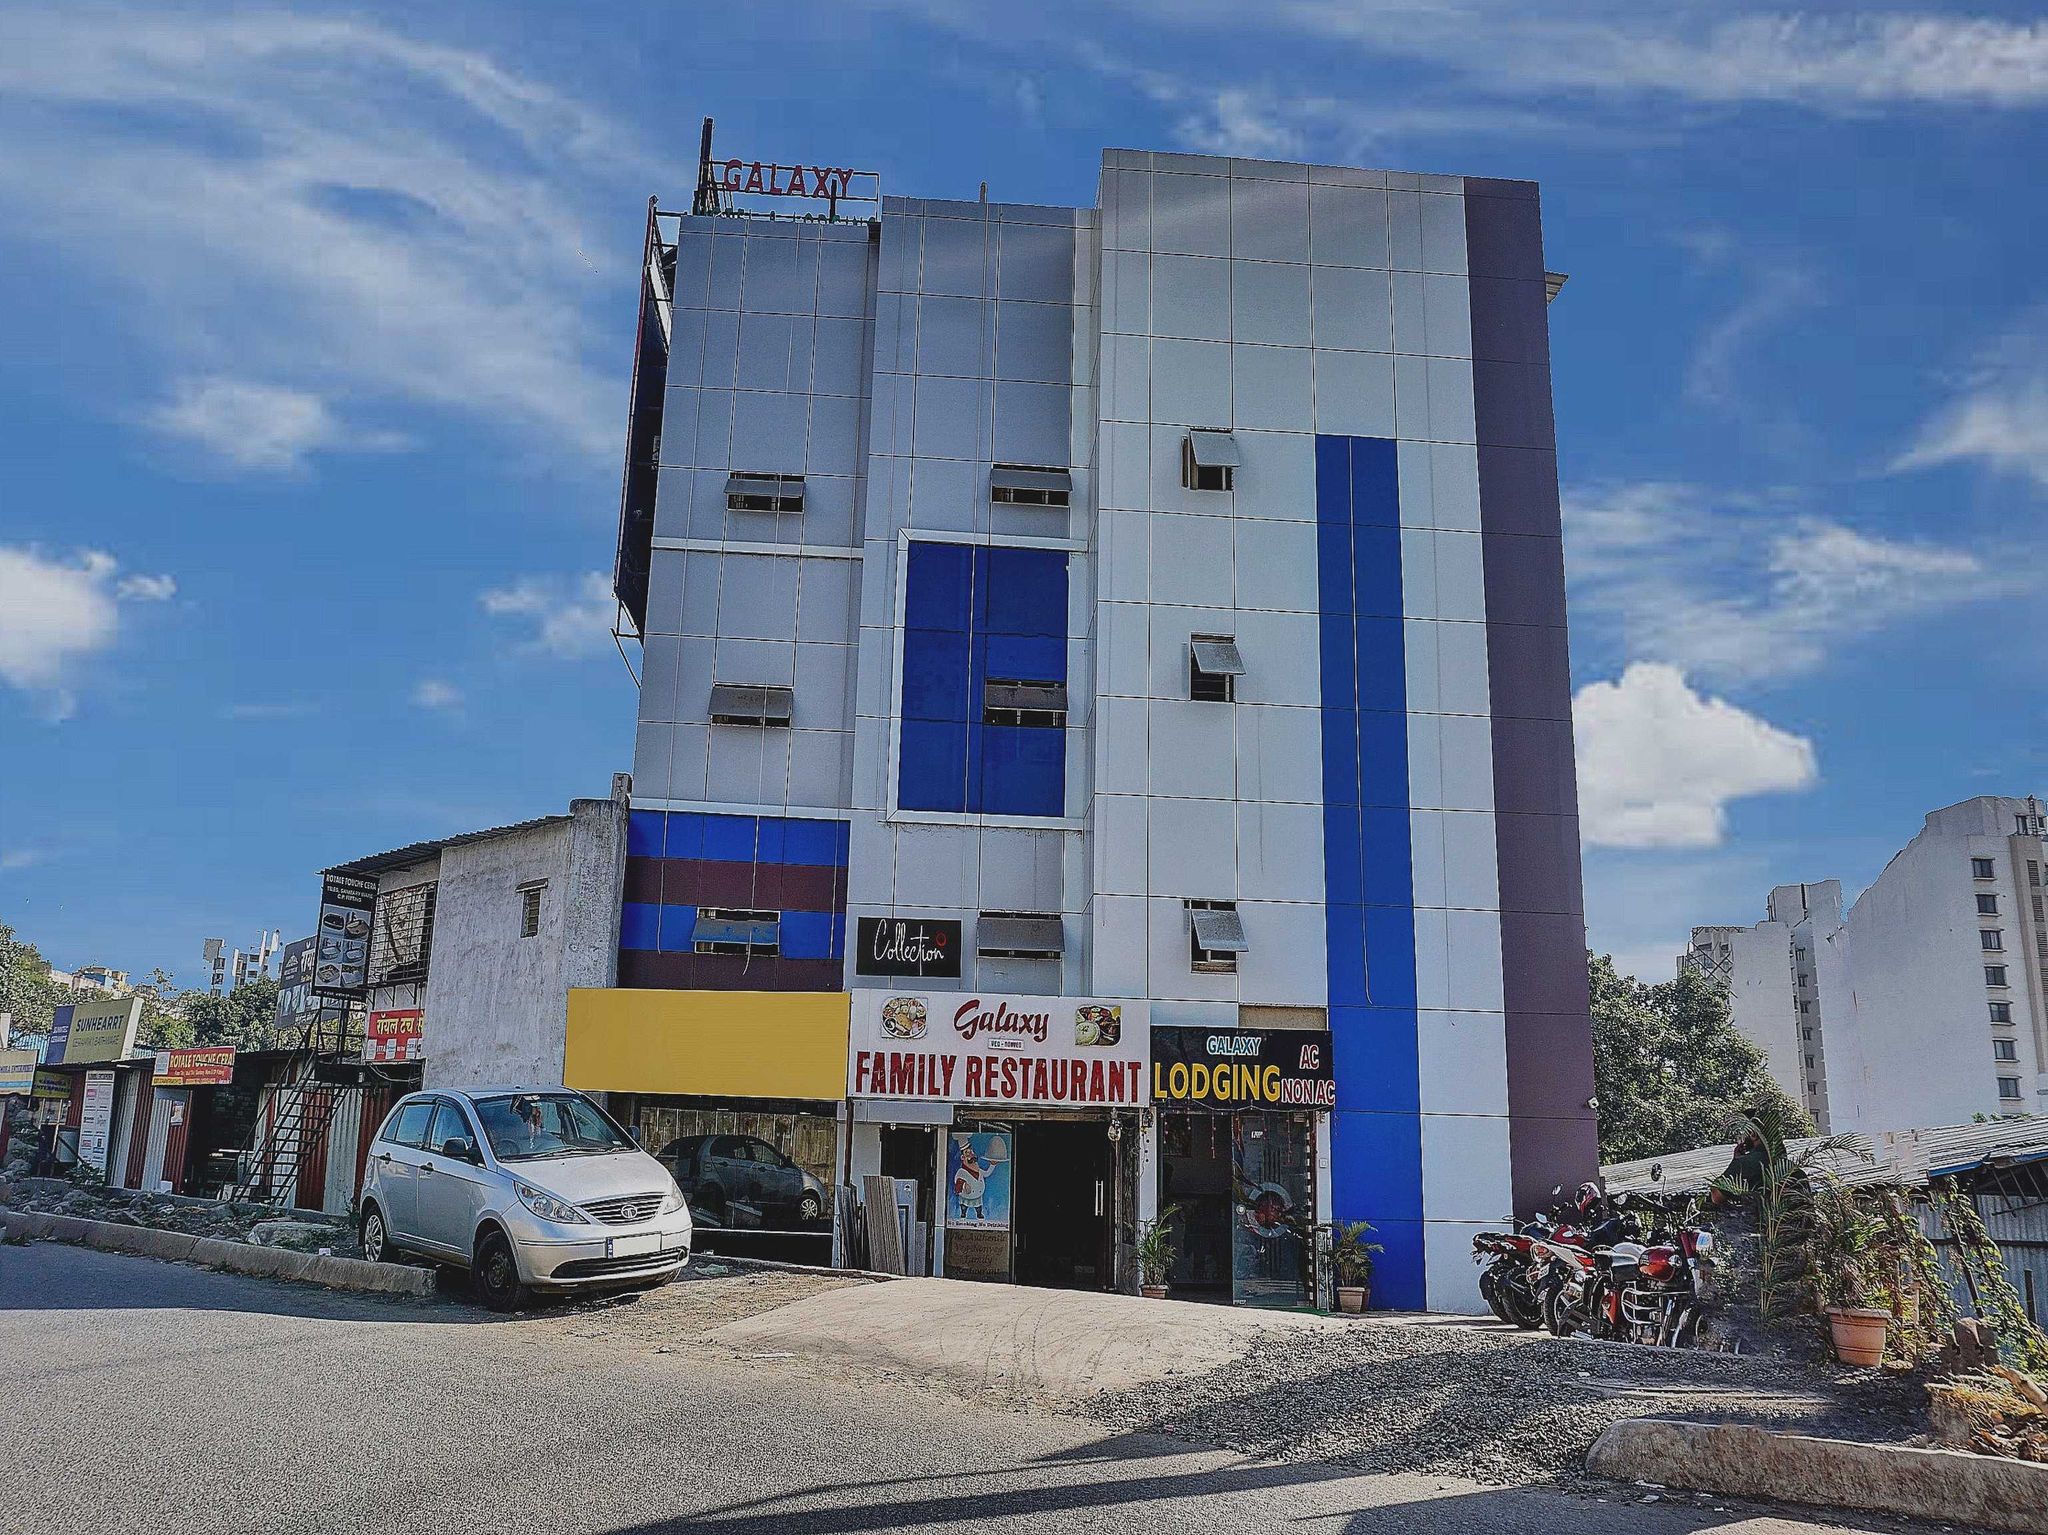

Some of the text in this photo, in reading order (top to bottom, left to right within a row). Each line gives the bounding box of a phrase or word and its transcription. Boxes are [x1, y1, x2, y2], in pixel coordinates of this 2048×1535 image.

[723, 159, 854, 199] GALAXY
[326, 874, 345, 885] ROYALE
[874, 919, 945, 976] Collection
[75, 1015, 125, 1032] SUNHEARRT
[376, 1012, 399, 1035] रॉयल
[953, 999, 1049, 1042] Galaxy
[1206, 1035, 1262, 1056] GALAXY
[1299, 1045, 1320, 1070] AC
[169, 1054, 192, 1068] ROYALE
[216, 1052, 233, 1066] CERA
[855, 1050, 1142, 1104] FAMILY RESTAURANT
[1154, 1062, 1336, 1106] LODGING NON AC
